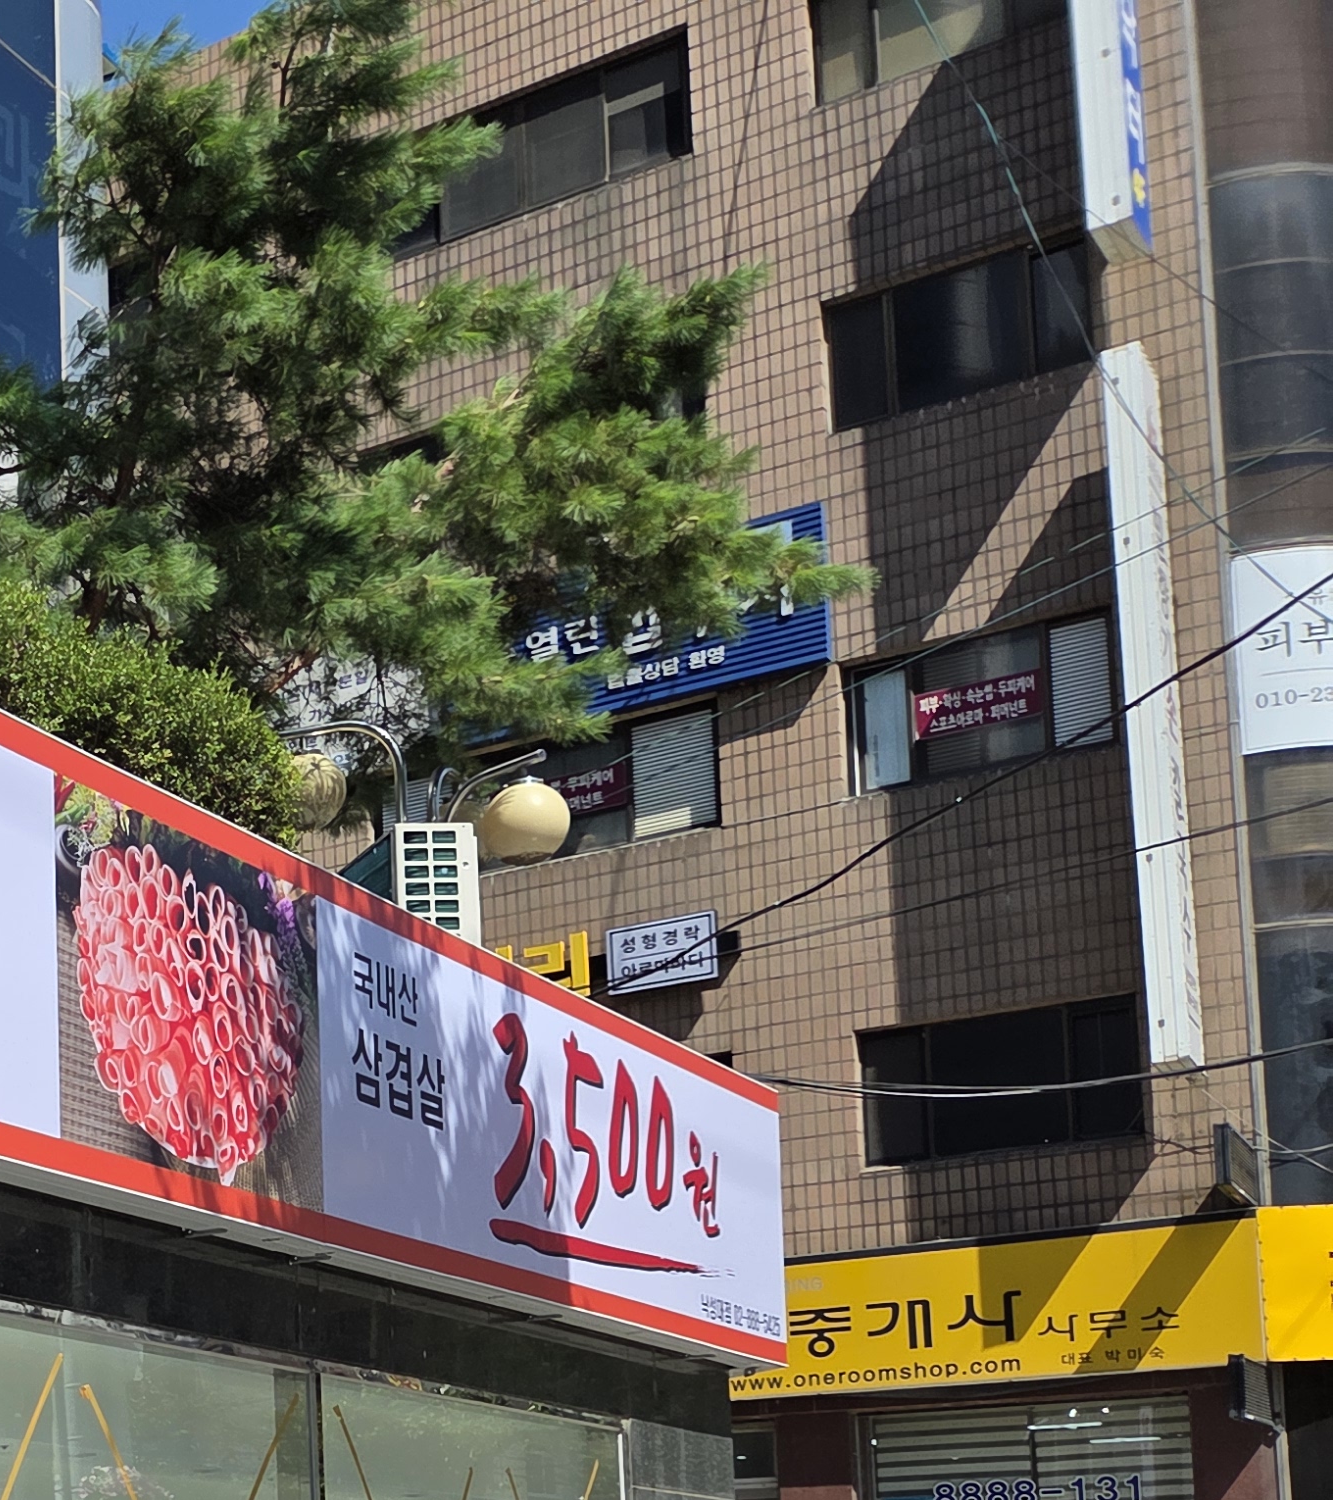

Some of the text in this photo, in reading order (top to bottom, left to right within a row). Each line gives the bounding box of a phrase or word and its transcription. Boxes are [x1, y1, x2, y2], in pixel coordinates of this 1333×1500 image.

[353, 951, 419, 1028] 국내산
[351, 1028, 446, 1131] 삼겹살
[1037, 1305, 1180, 1342] 사무소
[730, 1356, 1023, 1392] www.oneroomshop.com
[1060, 1351, 1094, 1366] 대표
